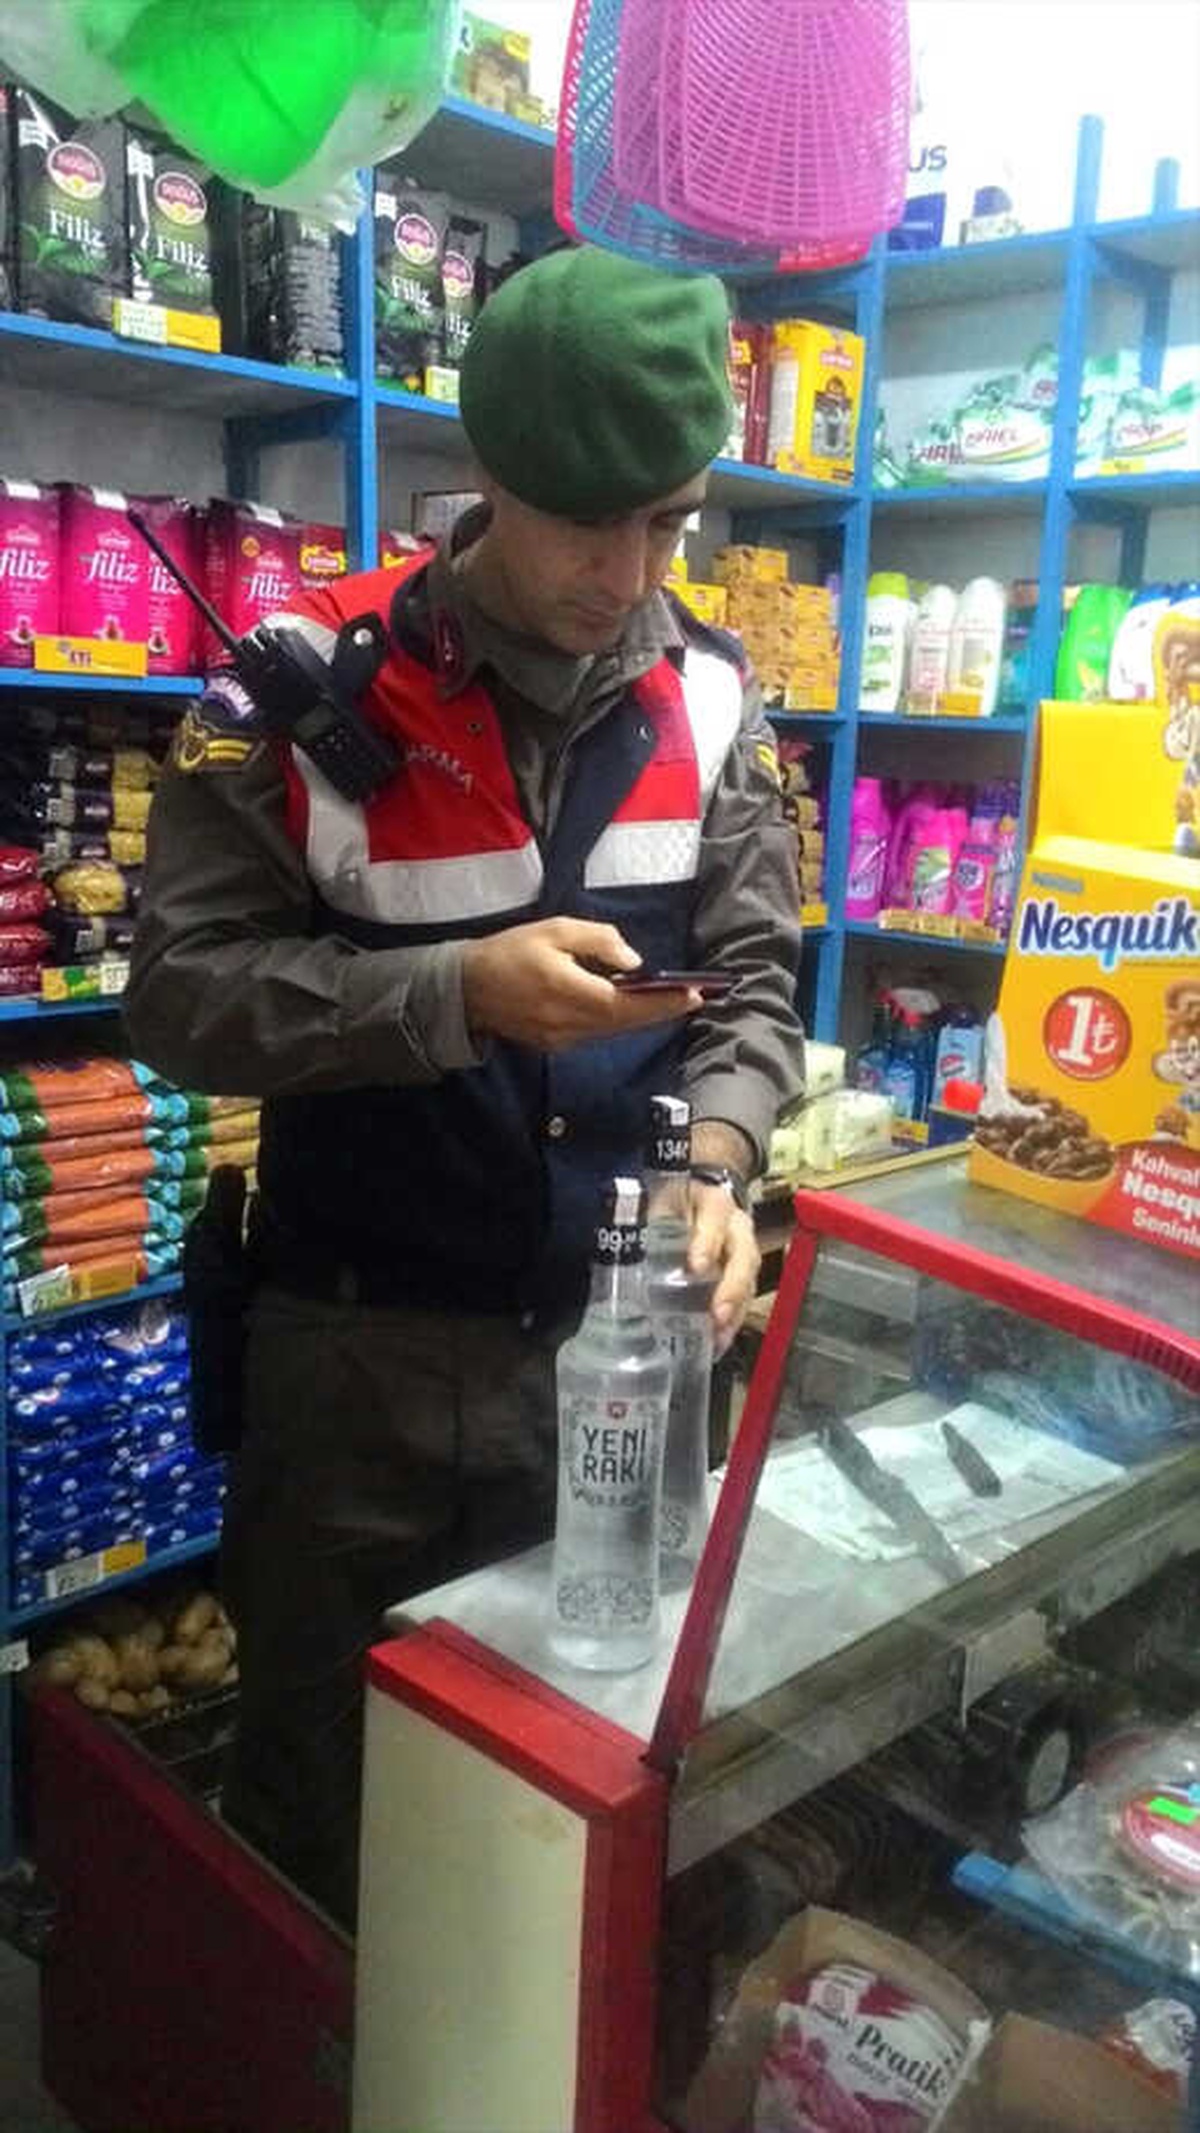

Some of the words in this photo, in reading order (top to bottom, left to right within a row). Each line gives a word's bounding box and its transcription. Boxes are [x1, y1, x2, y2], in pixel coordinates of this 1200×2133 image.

[907, 145, 947, 172] US
[50, 208, 106, 249] Filiz
[157, 234, 208, 271] Filiz
[0, 547, 50, 580] filiz
[88, 549, 140, 584] filiz
[247, 572, 292, 603] filiz
[406, 743, 474, 797] ARMA
[1018, 897, 1199, 969] Nesquik
[1132, 1149, 1200, 1188] Kahval
[582, 1425, 646, 1456] YENI
[582, 1453, 643, 1483] RAKI
[855, 2024, 946, 2099] Pratik
